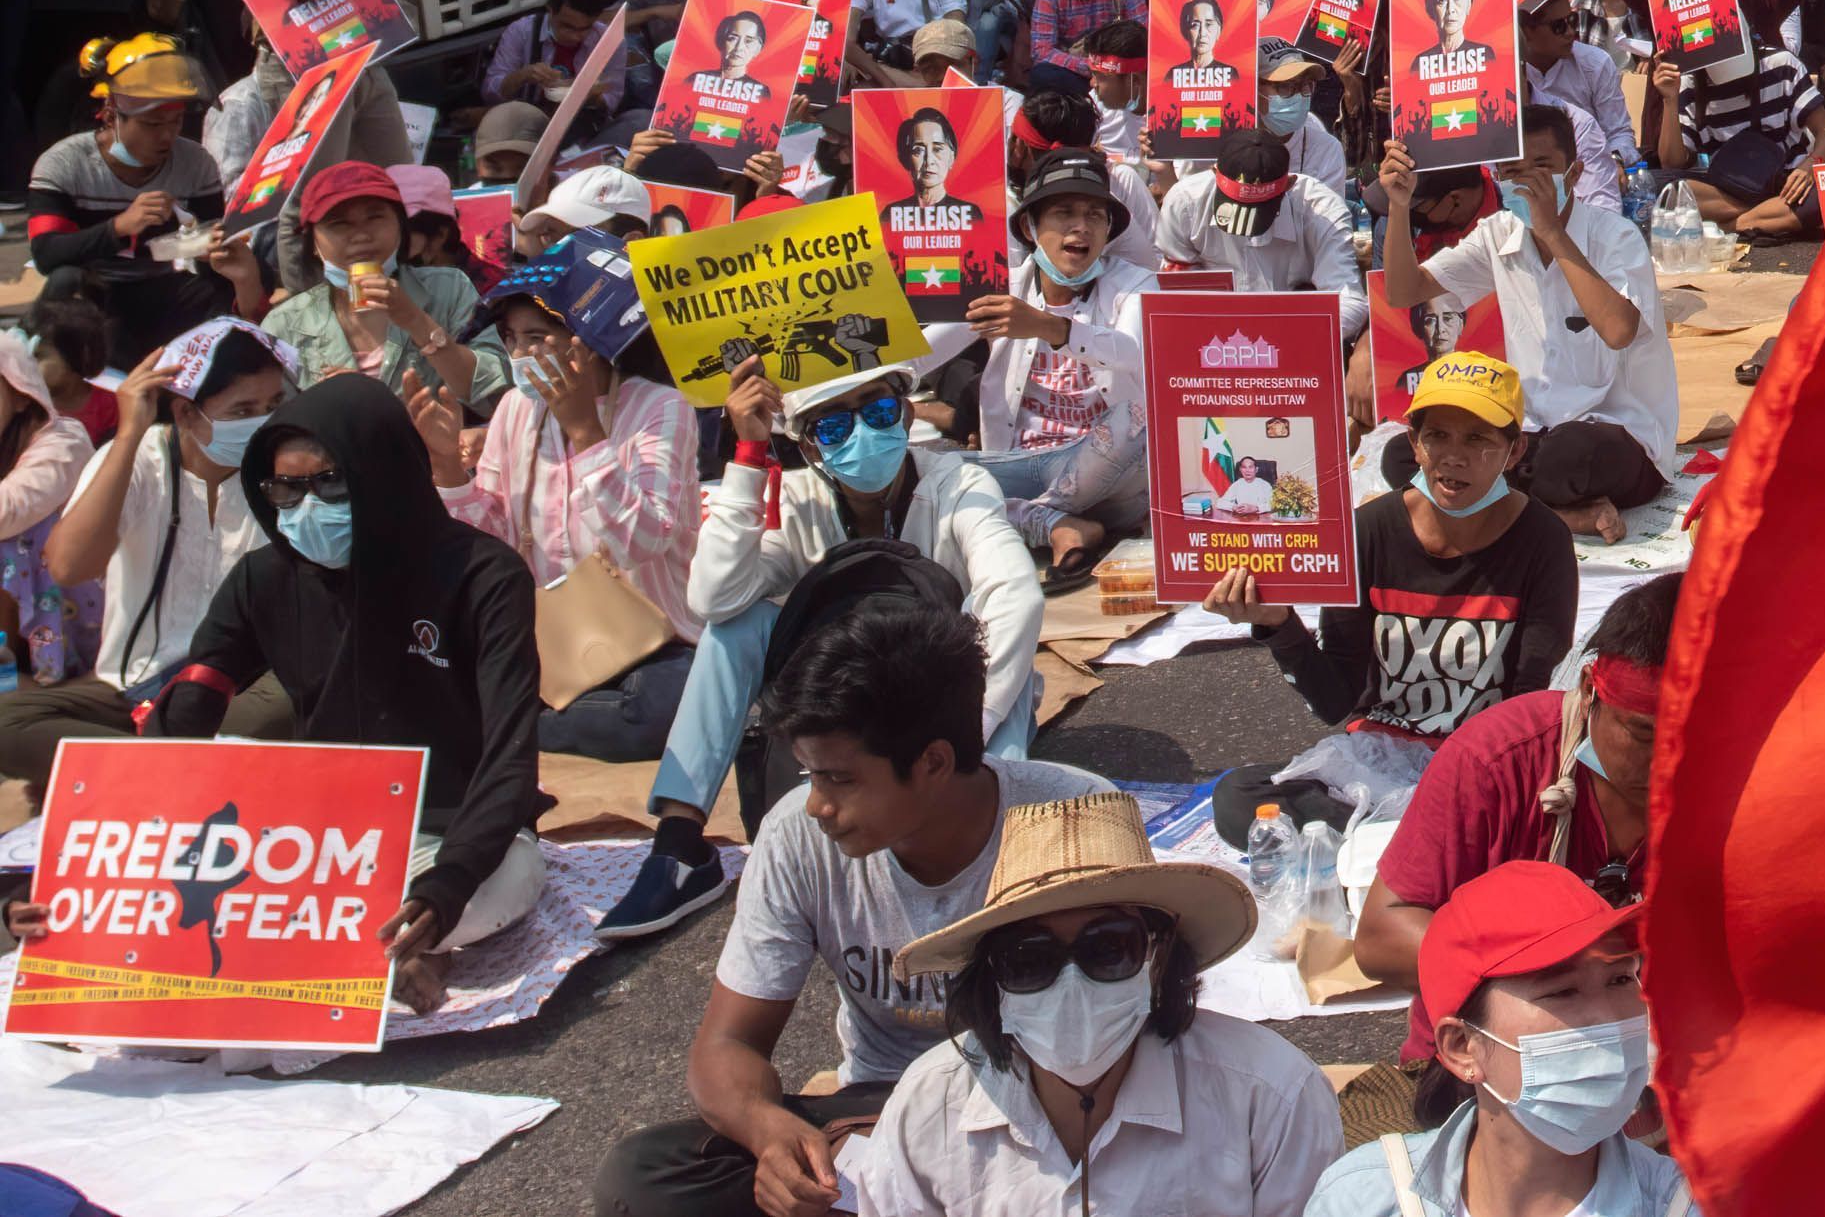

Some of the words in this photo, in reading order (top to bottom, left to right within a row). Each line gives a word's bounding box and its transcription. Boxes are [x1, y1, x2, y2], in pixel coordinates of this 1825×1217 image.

[1418, 47, 1486, 80] RELEASE
[1172, 67, 1231, 89] RELEASE
[1429, 80, 1446, 96] OUR
[1447, 77, 1478, 94] LEADER
[693, 74, 763, 104] RELEASE
[1180, 90, 1195, 102] OUR
[1196, 89, 1223, 102] LEADER
[698, 97, 714, 109] OUR
[715, 99, 748, 115] LEADER
[890, 205, 972, 231] RELEASE
[903, 235, 922, 249] OUR
[925, 235, 961, 249] LEADER
[644, 264, 690, 293] We
[696, 243, 776, 281] Don't
[782, 225, 872, 266] Accept
[662, 277, 791, 326] MILITARY
[798, 261, 874, 299] COUP
[1204, 345, 1272, 366] CRPH
[1169, 377, 1232, 389] COMMITTEE
[1235, 377, 1319, 389] REPRESENTING
[1182, 393, 1252, 406] PYIDAUNGSU
[1255, 394, 1306, 406] HLUTTAW
[1188, 532, 1208, 548] WE
[1211, 533, 1249, 548] STAND
[1252, 533, 1282, 548] WITH
[1285, 534, 1318, 549] CRPH
[1170, 552, 1199, 572] WE
[1203, 552, 1285, 573] SUPPORT
[1290, 553, 1340, 573] CRPH
[1374, 615, 1516, 690] OXOX
[56, 819, 383, 885] FREEDOM
[48, 887, 176, 936] OVER
[211, 893, 368, 941] FEAR
[150, 975, 192, 988] FREEDOM
[251, 985, 295, 998] FREEDOM
[297, 989, 321, 1001] OVER
[335, 981, 359, 991] OVER
[362, 980, 385, 991] FEAR
